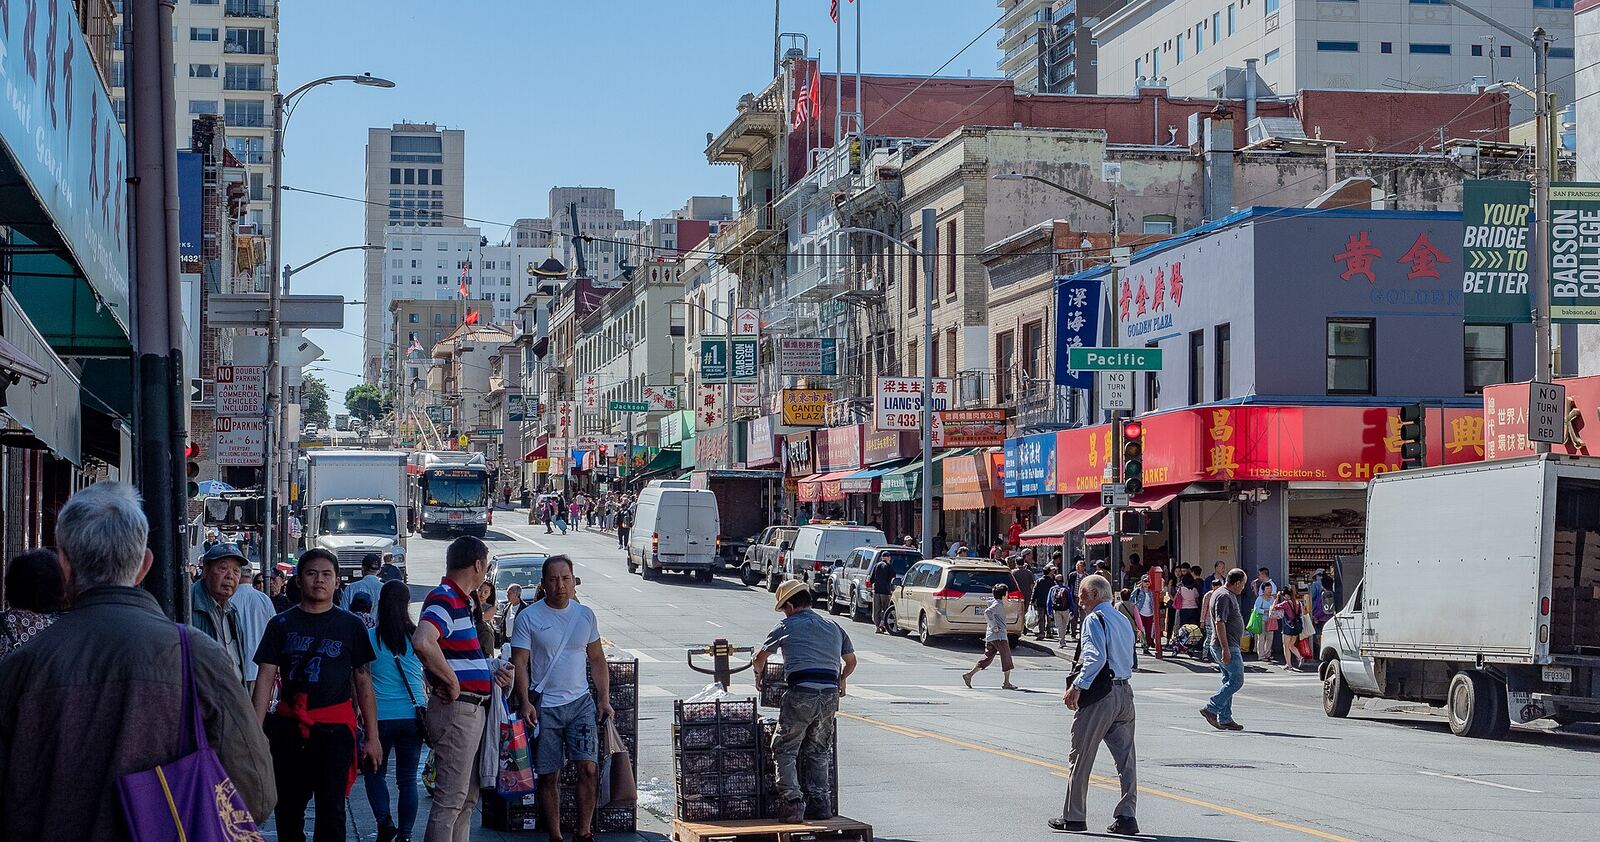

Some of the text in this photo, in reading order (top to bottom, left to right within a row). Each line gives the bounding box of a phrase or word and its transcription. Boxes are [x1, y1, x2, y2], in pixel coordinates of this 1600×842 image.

[36, 127, 73, 208] Garden
[1484, 204, 1529, 225] YOUR
[1463, 226, 1529, 248] BRIDGE
[1333, 230, 1454, 284] 黃金
[1507, 250, 1528, 272] TO
[1552, 209, 1578, 298] BABSON
[1578, 209, 1600, 298] COLLEGE
[1463, 272, 1528, 294] BETTER
[1562, 306, 1596, 316] babson.edu
[1128, 313, 1173, 338] GOLDEN PLAZA
[702, 344, 721, 364] #1.
[736, 344, 745, 376] BABSON
[745, 344, 754, 375] COLLEGE
[1087, 354, 1144, 366] Pacific
[219, 368, 231, 381] NO
[884, 380, 947, 393] 梁生生產
[1540, 388, 1556, 400] NO
[884, 397, 920, 410] LIANG'S
[1537, 402, 1557, 413] TURN
[898, 414, 919, 426] 433-
[1498, 407, 1529, 425] 世界人
[1540, 416, 1552, 425] ON
[217, 418, 262, 430] NO PARKING
[219, 435, 224, 444] 2
[245, 436, 250, 444] 6
[1539, 428, 1554, 438] RED
[1142, 467, 1168, 484] ARKET
[1273, 469, 1312, 477] Stockton
[1076, 476, 1097, 490] CHONG
